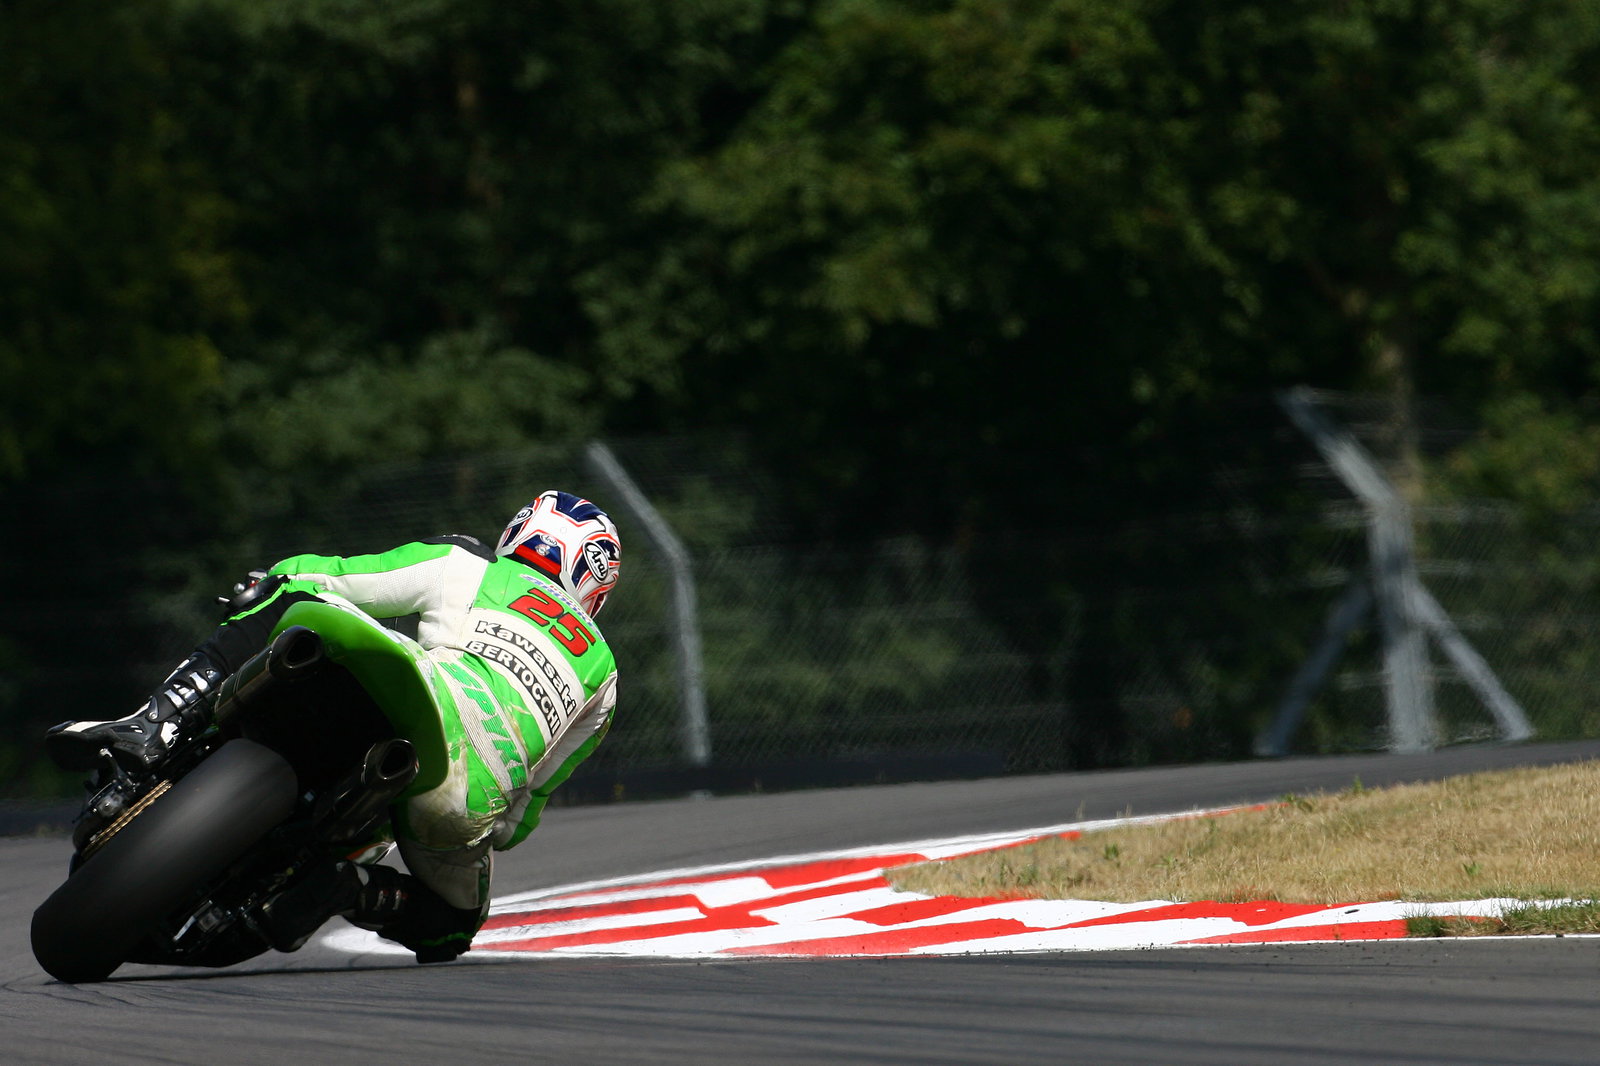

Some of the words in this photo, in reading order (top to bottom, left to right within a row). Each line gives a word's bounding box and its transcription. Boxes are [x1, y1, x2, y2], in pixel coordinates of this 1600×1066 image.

[586, 548, 608, 577] Arai
[507, 587, 596, 657] 25
[466, 640, 562, 738] BERTOCCHI
[475, 620, 577, 719] Kawasaki
